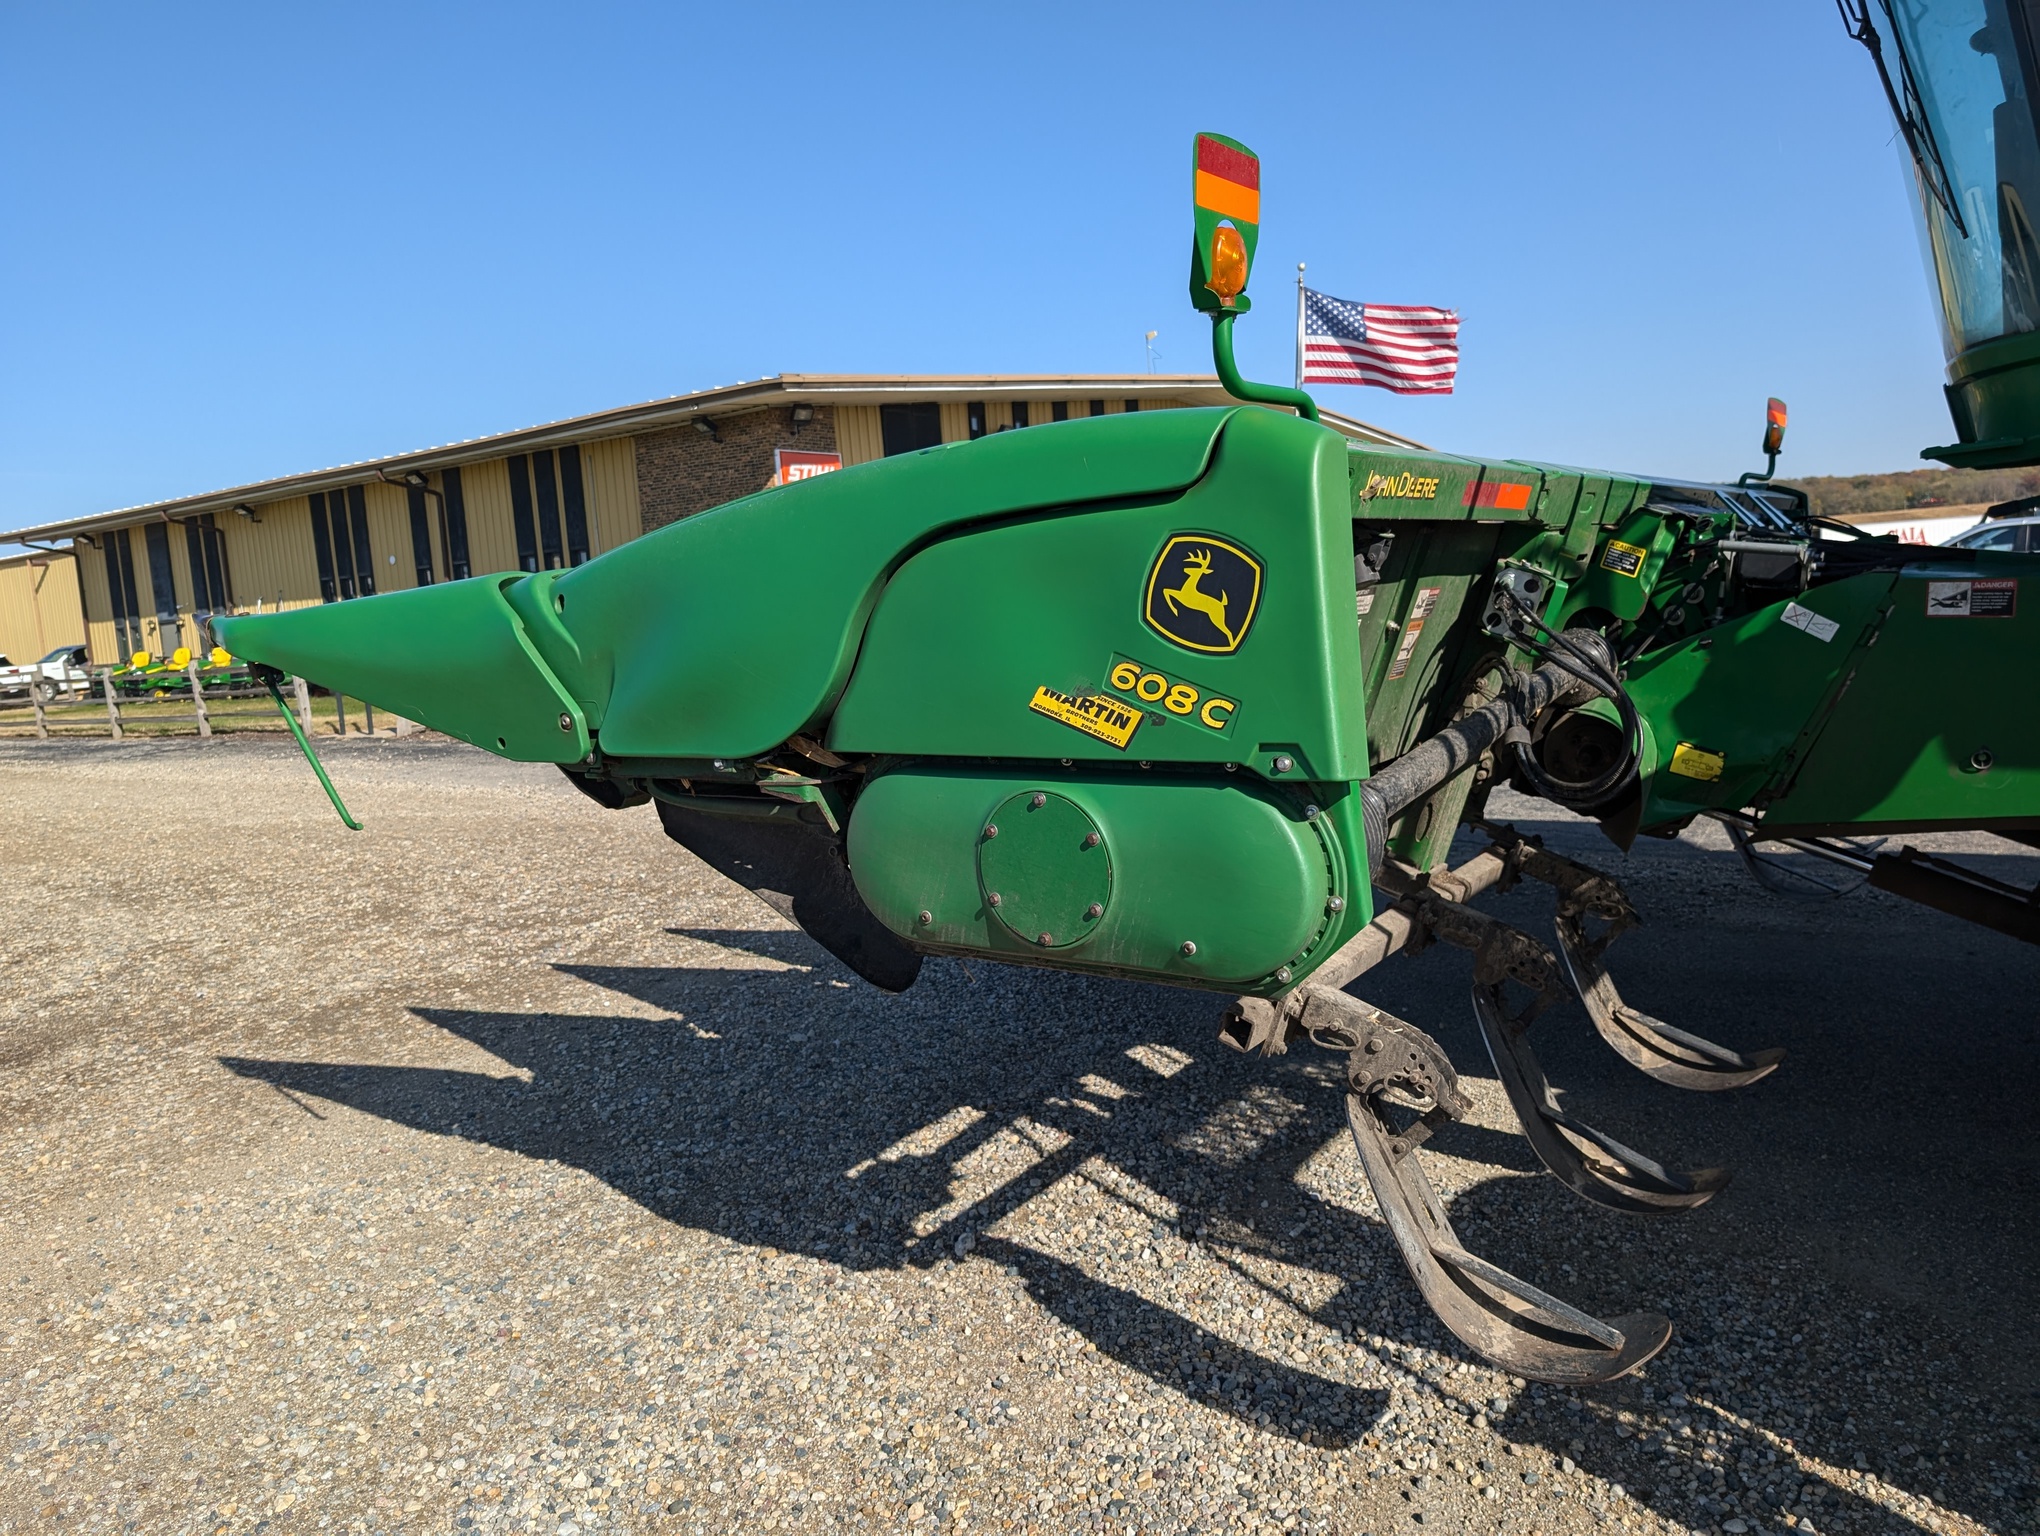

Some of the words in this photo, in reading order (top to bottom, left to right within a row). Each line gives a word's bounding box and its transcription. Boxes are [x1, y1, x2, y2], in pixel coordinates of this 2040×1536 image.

[787, 463, 836, 482] STIH
[1396, 472, 1439, 498] DEERE
[1615, 542, 1644, 556] CAUTION
[1980, 581, 2014, 589] DANGER
[1065, 708, 1099, 726] BROTHERS
